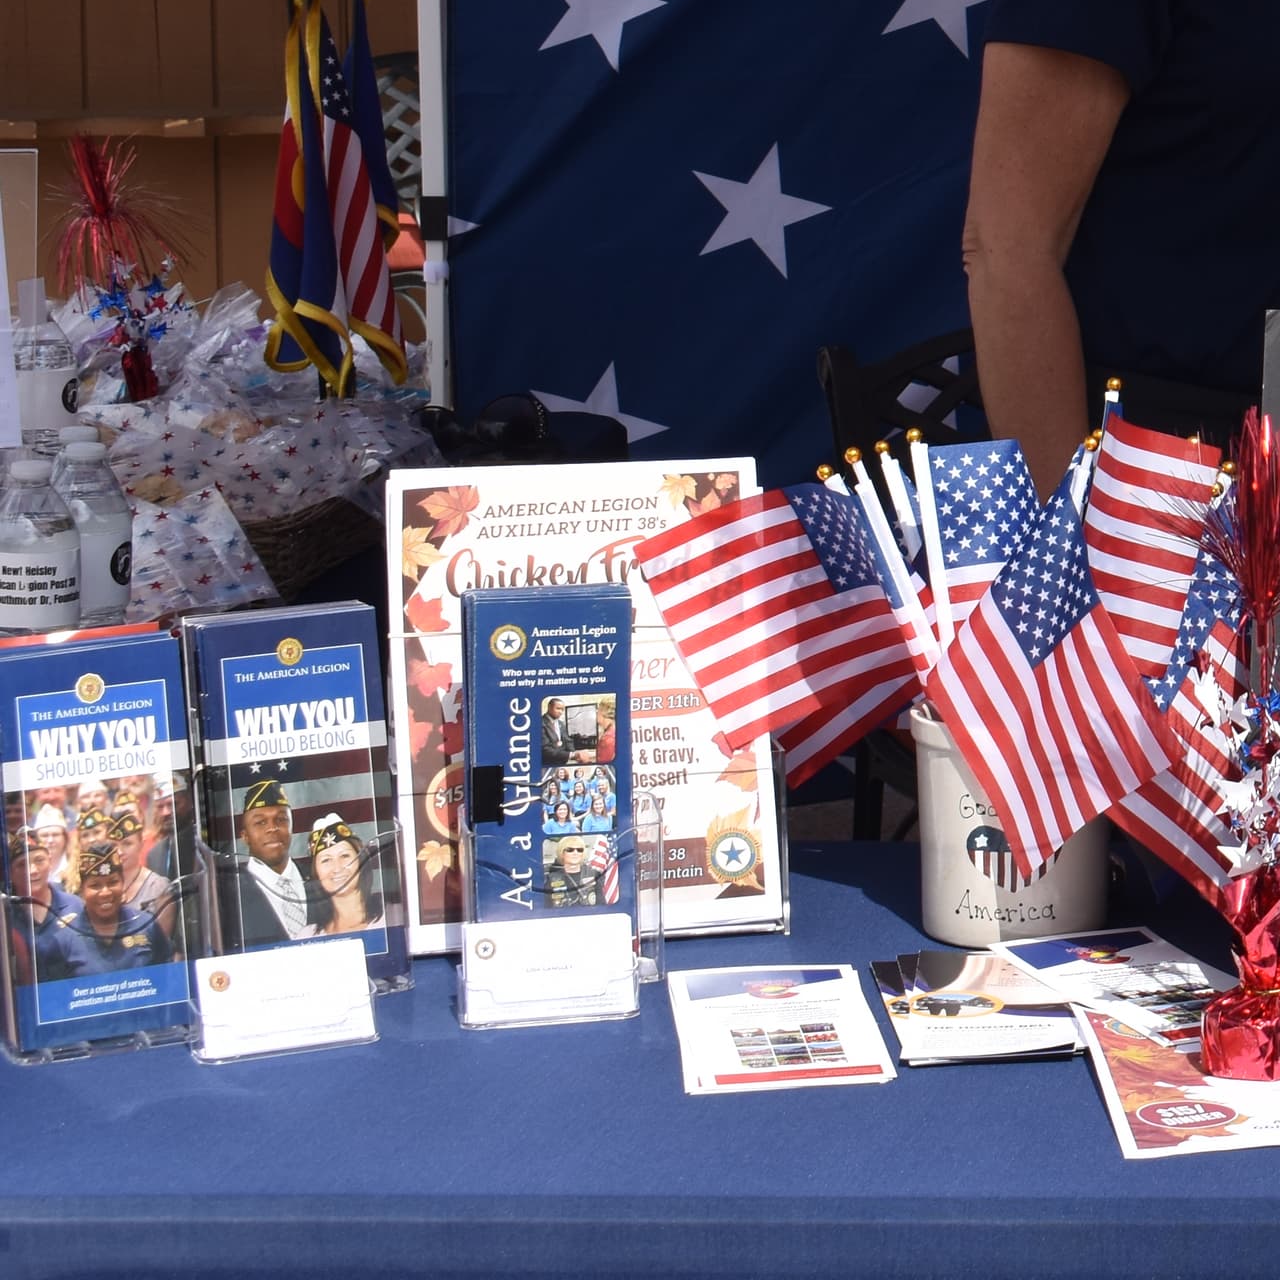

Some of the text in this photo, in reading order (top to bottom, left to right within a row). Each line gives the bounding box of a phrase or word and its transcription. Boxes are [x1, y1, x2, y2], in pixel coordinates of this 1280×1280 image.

[483, 496, 659, 519] AMERICAN LEGION
[476, 516, 667, 540] AUXILIARY UNIT 38's
[25, 566, 57, 576] Heisley
[531, 624, 616, 638] American Legion
[530, 637, 617, 660] Auxiliary
[234, 662, 350, 683] THE AMERICAN LEGION
[500, 676, 606, 688] and why matters to you
[502, 669, 522, 677] Who
[31, 699, 153, 721] THE AMERICAN LEGION
[667, 692, 700, 709] 11th
[235, 697, 355, 738] WHY YOU
[30, 716, 156, 760] WHY YOU
[241, 729, 355, 758] SHOULD BELONG
[36, 749, 156, 781] SHOULD BELONG
[653, 746, 699, 764] Gravy,
[509, 831, 533, 850] a
[668, 847, 686, 861] 38
[500, 867, 533, 910] At
[955, 888, 1057, 923] America
[73, 988, 89, 997] Over
